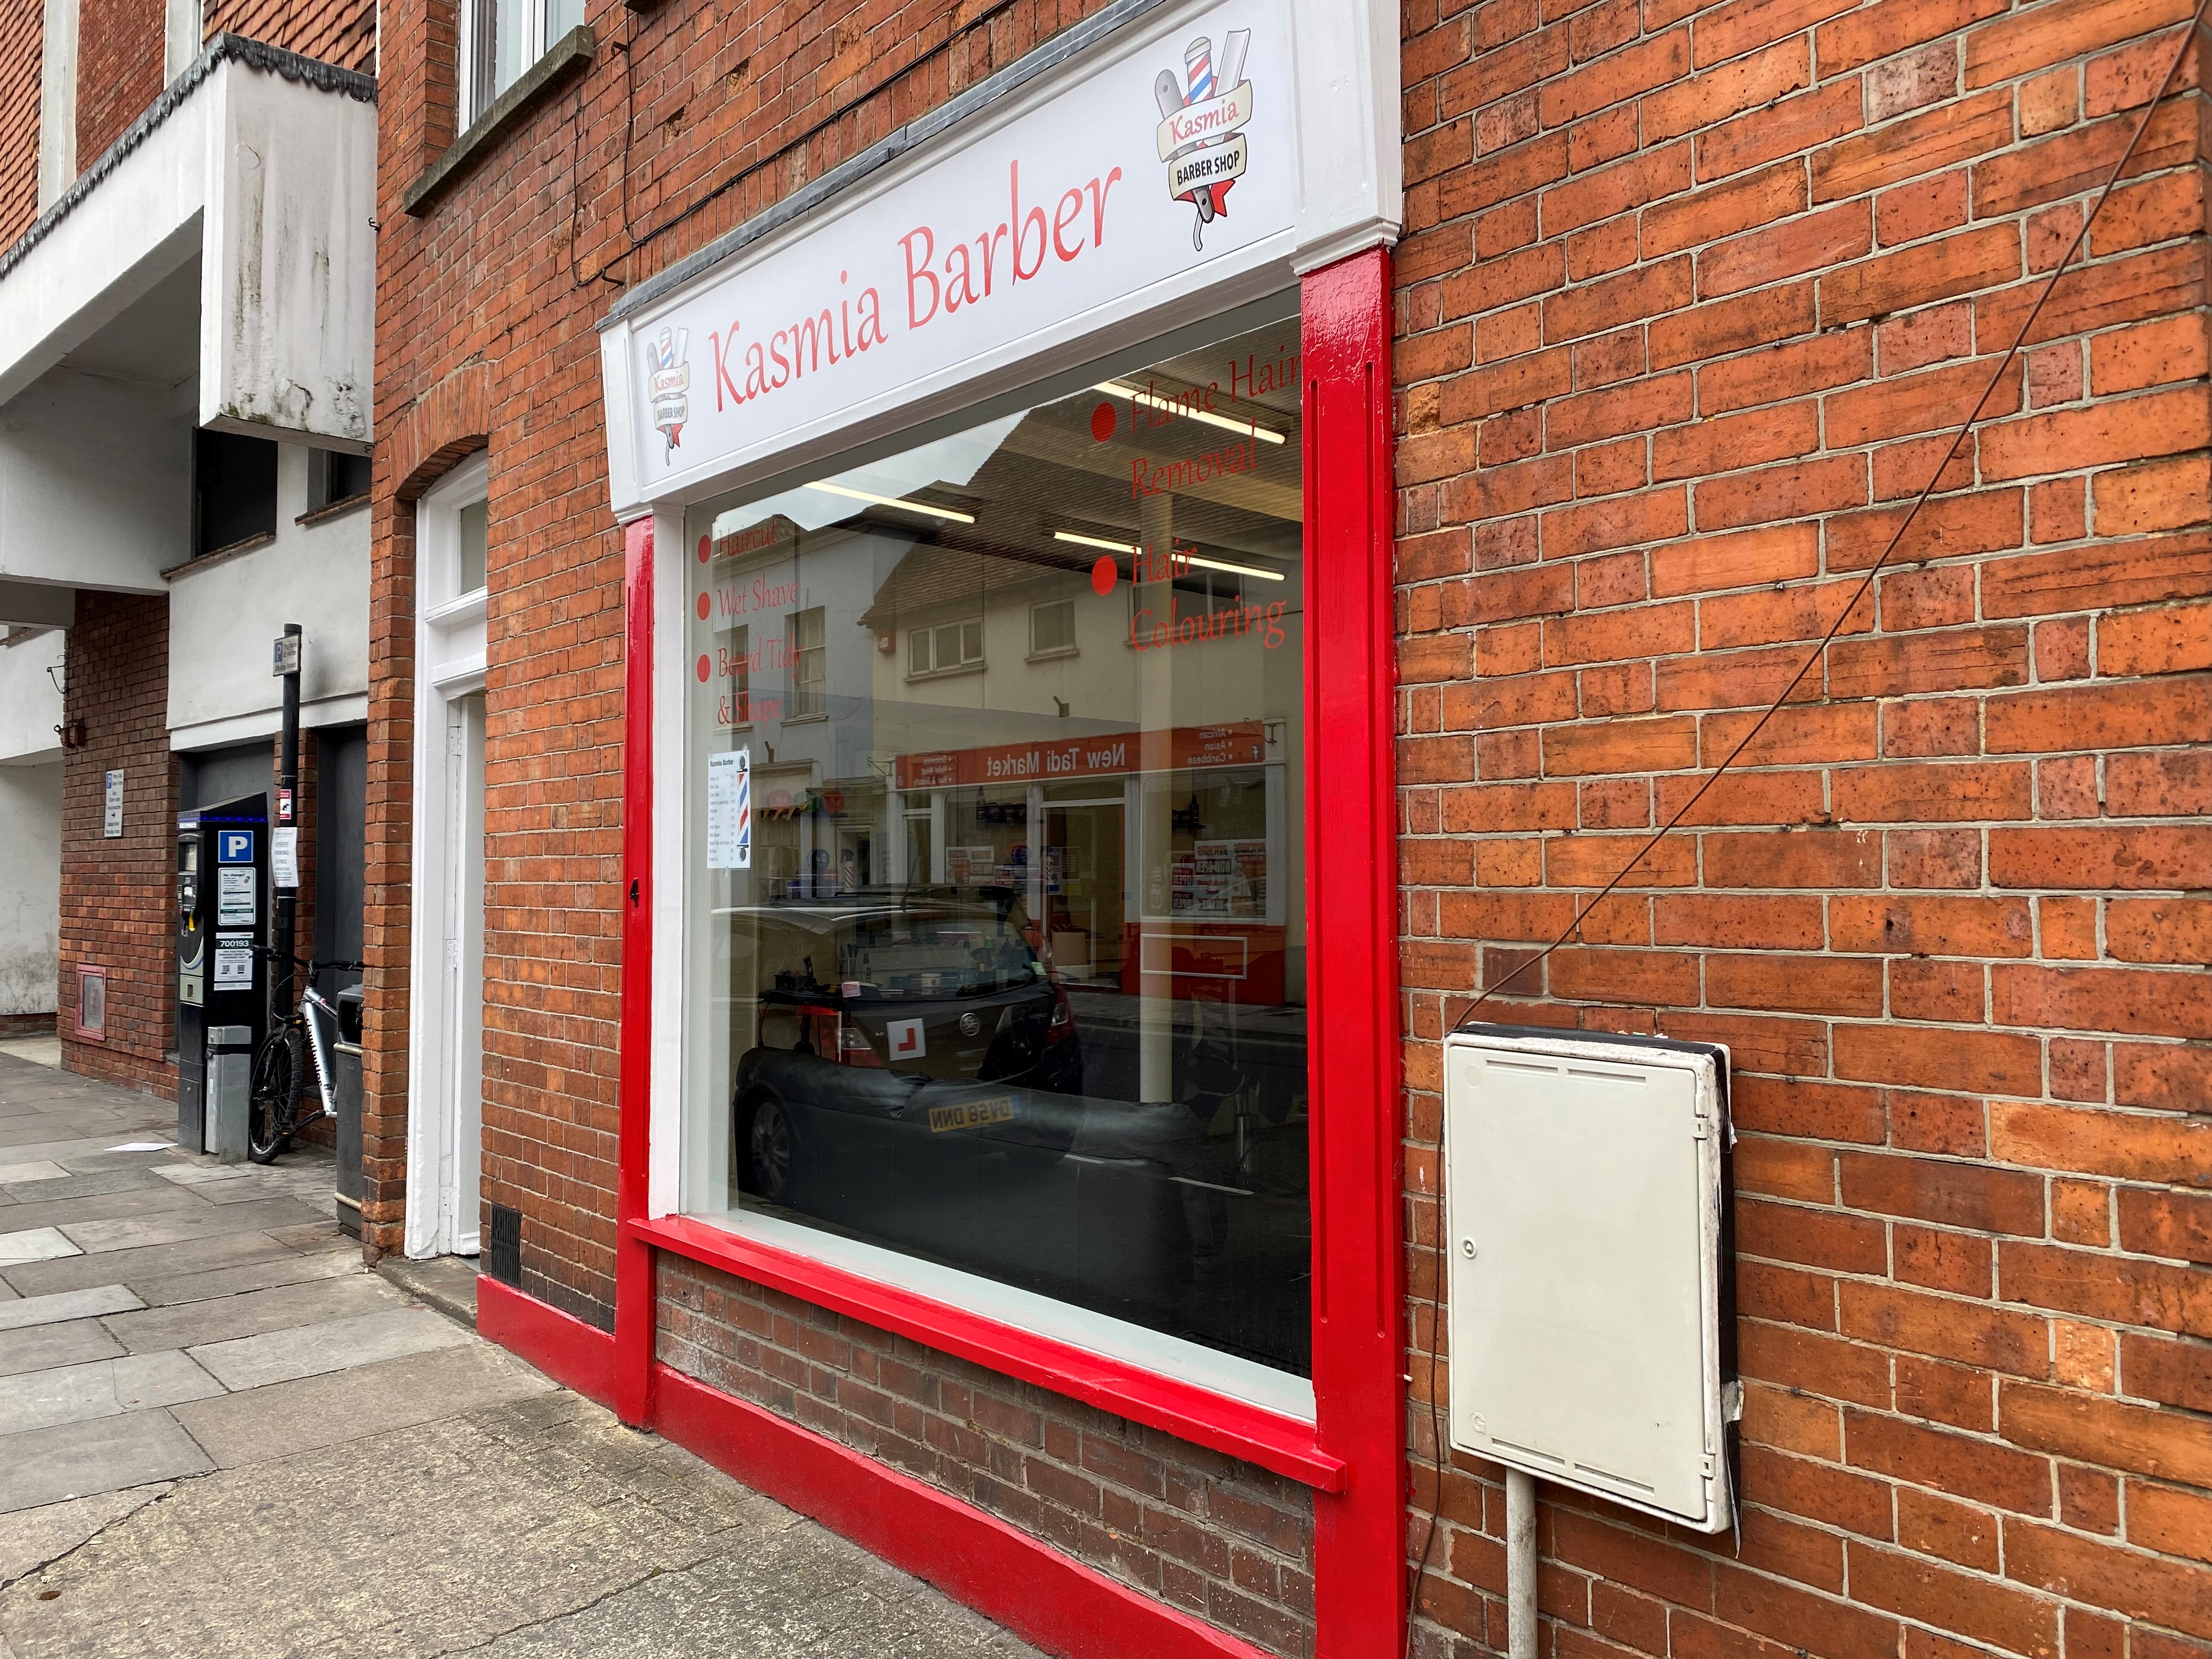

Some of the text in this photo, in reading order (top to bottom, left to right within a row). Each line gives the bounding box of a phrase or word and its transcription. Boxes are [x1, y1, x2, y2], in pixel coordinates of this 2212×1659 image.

[1169, 99, 1239, 145] Kasmia
[1177, 150, 1240, 187] BARBER SHOP
[708, 159, 1122, 413] Kasmia Barber
[653, 370, 684, 393] Kasmia
[1129, 345, 1302, 435] Flame Hair
[658, 405, 685, 421] BARBER SHOP
[1130, 417, 1259, 500] Removal
[719, 520, 777, 558] Haircut
[1131, 537, 1197, 586] Hair
[717, 573, 798, 617] Wet Shave
[1130, 594, 1286, 651] Colouring
[718, 630, 804, 680] Beard Tidy
[718, 686, 782, 732] & Shape
[228, 836, 247, 857] P
[1470, 1411, 1486, 1435] G
